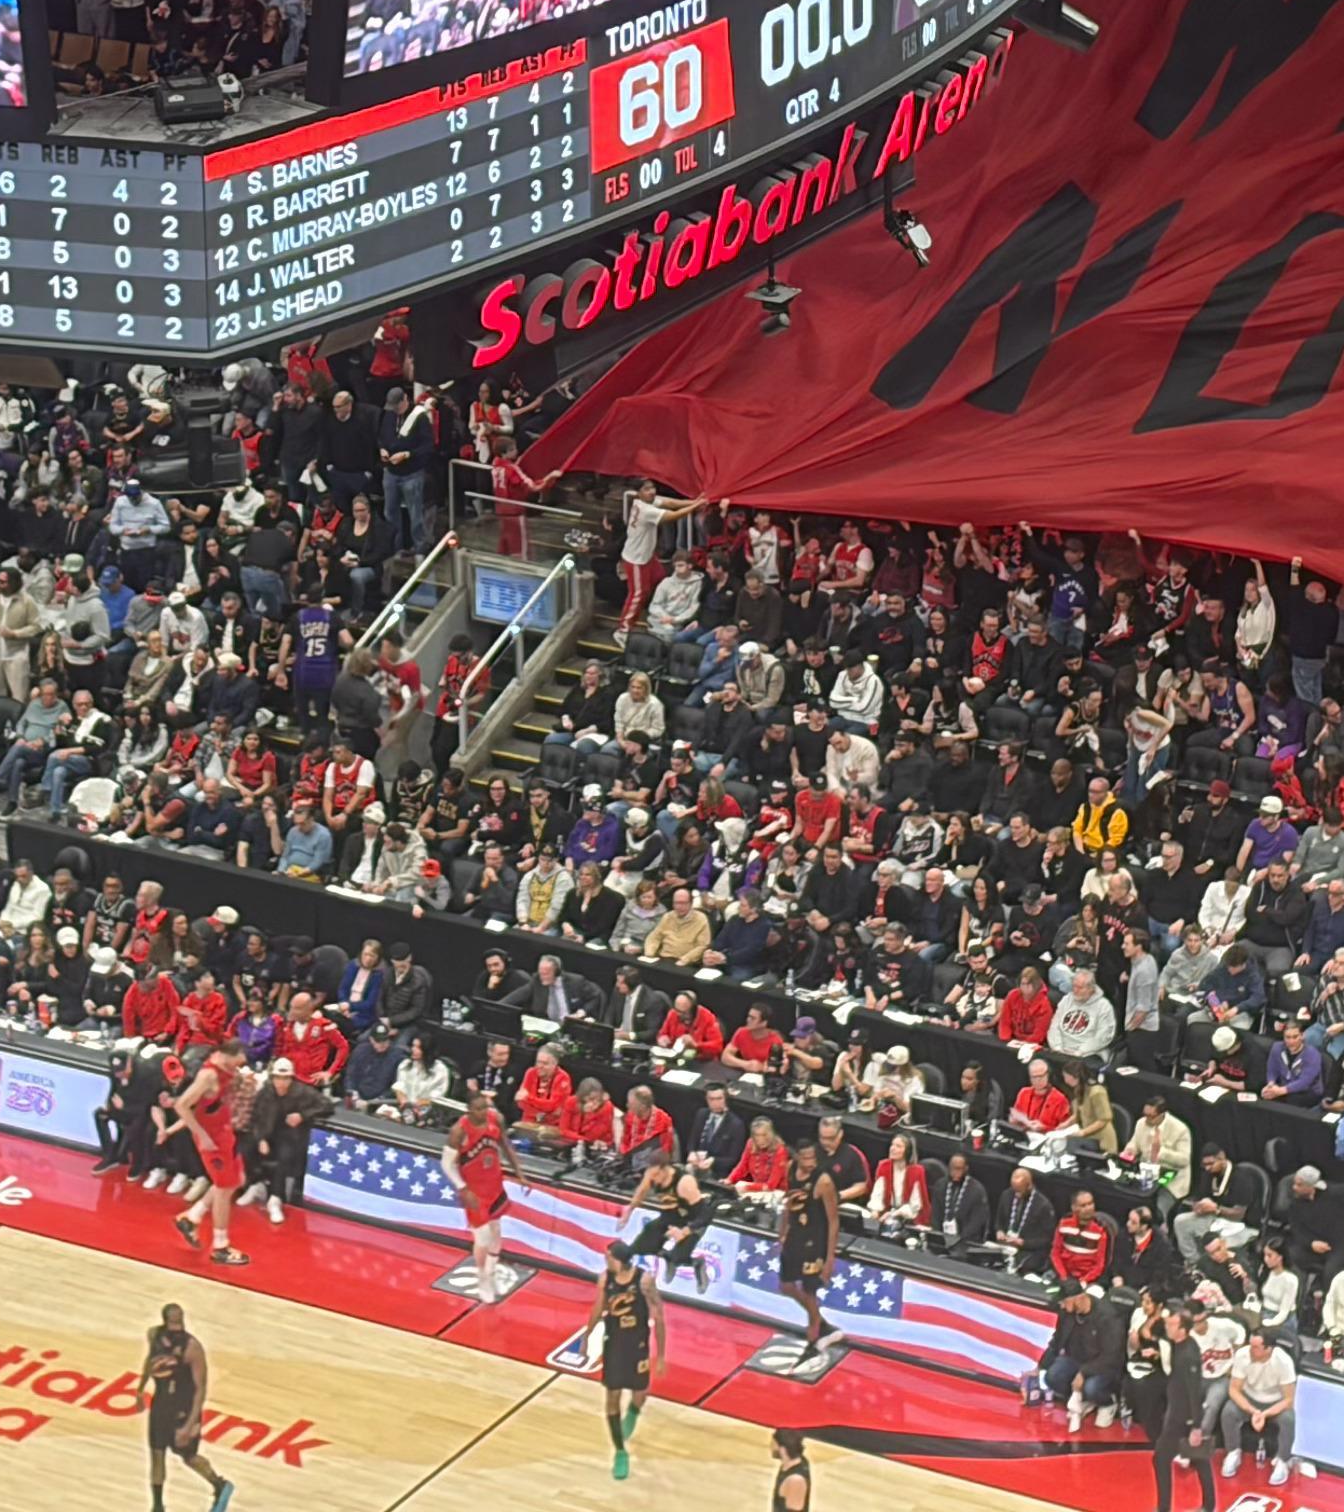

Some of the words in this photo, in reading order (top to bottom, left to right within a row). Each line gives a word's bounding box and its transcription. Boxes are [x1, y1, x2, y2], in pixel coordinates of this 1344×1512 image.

[619, 44, 702, 146] 60
[786, 88, 820, 125] QTR
[829, 77, 841, 103] 4
[42, 145, 79, 165] REB
[100, 149, 141, 169] AST
[164, 154, 188, 172] PF
[219, 179, 233, 202] 4
[247, 171, 268, 195] S.
[273, 143, 358, 188] BARNES
[49, 175, 67, 198] 2
[112, 179, 128, 202] 4
[160, 182, 178, 205] 2
[219, 214, 233, 236] 9
[247, 205, 268, 229] R.
[273, 171, 369, 221] BARRETT
[472, 122, 867, 369] Scotiabank
[874, 27, 1014, 179] Arena
[51, 207, 67, 232] 7
[113, 212, 130, 235] 0
[161, 215, 179, 239] 2
[214, 246, 239, 272] 12
[247, 238, 268, 262] C.
[272, 182, 437, 254] MURRAY-BOYLES
[53, 241, 70, 264] 5
[115, 245, 132, 269] 0
[163, 249, 180, 272] 3
[215, 279, 240, 306] 14
[247, 273, 266, 297] J.
[270, 244, 355, 288] WALTER
[48, 275, 78, 300] 13
[116, 280, 133, 304] 0
[164, 283, 181, 307] 3
[215, 313, 240, 340] 23
[248, 306, 267, 330] J.
[272, 280, 342, 322] SHEAD
[56, 309, 72, 332] 5
[117, 313, 134, 337] 2
[165, 317, 183, 340] 2
[306, 638, 327, 657] 15
